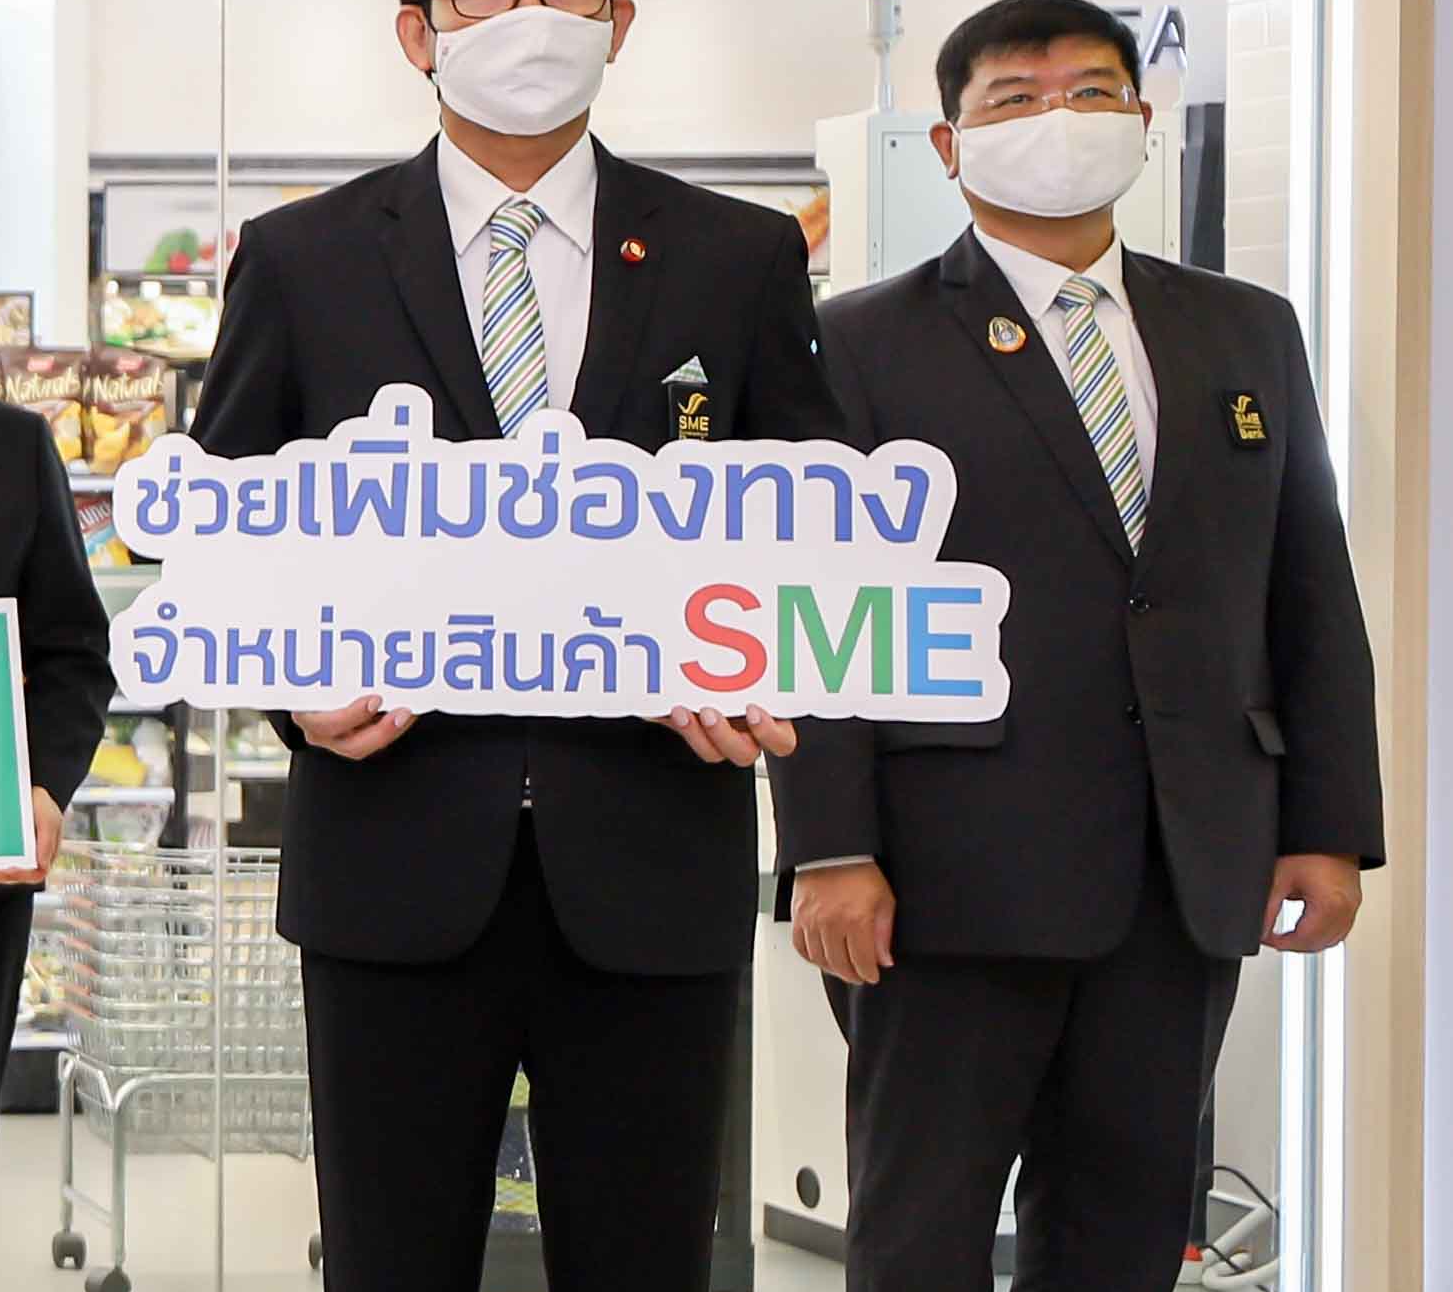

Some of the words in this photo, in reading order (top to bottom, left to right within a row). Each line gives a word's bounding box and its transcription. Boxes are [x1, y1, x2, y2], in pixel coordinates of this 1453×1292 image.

[135, 404, 931, 543] ช่วยเพิ่มช่องทาง
[678, 415, 710, 431] SME
[132, 602, 662, 694] จำหน่ายสินค้า
[679, 583, 984, 698] SME
